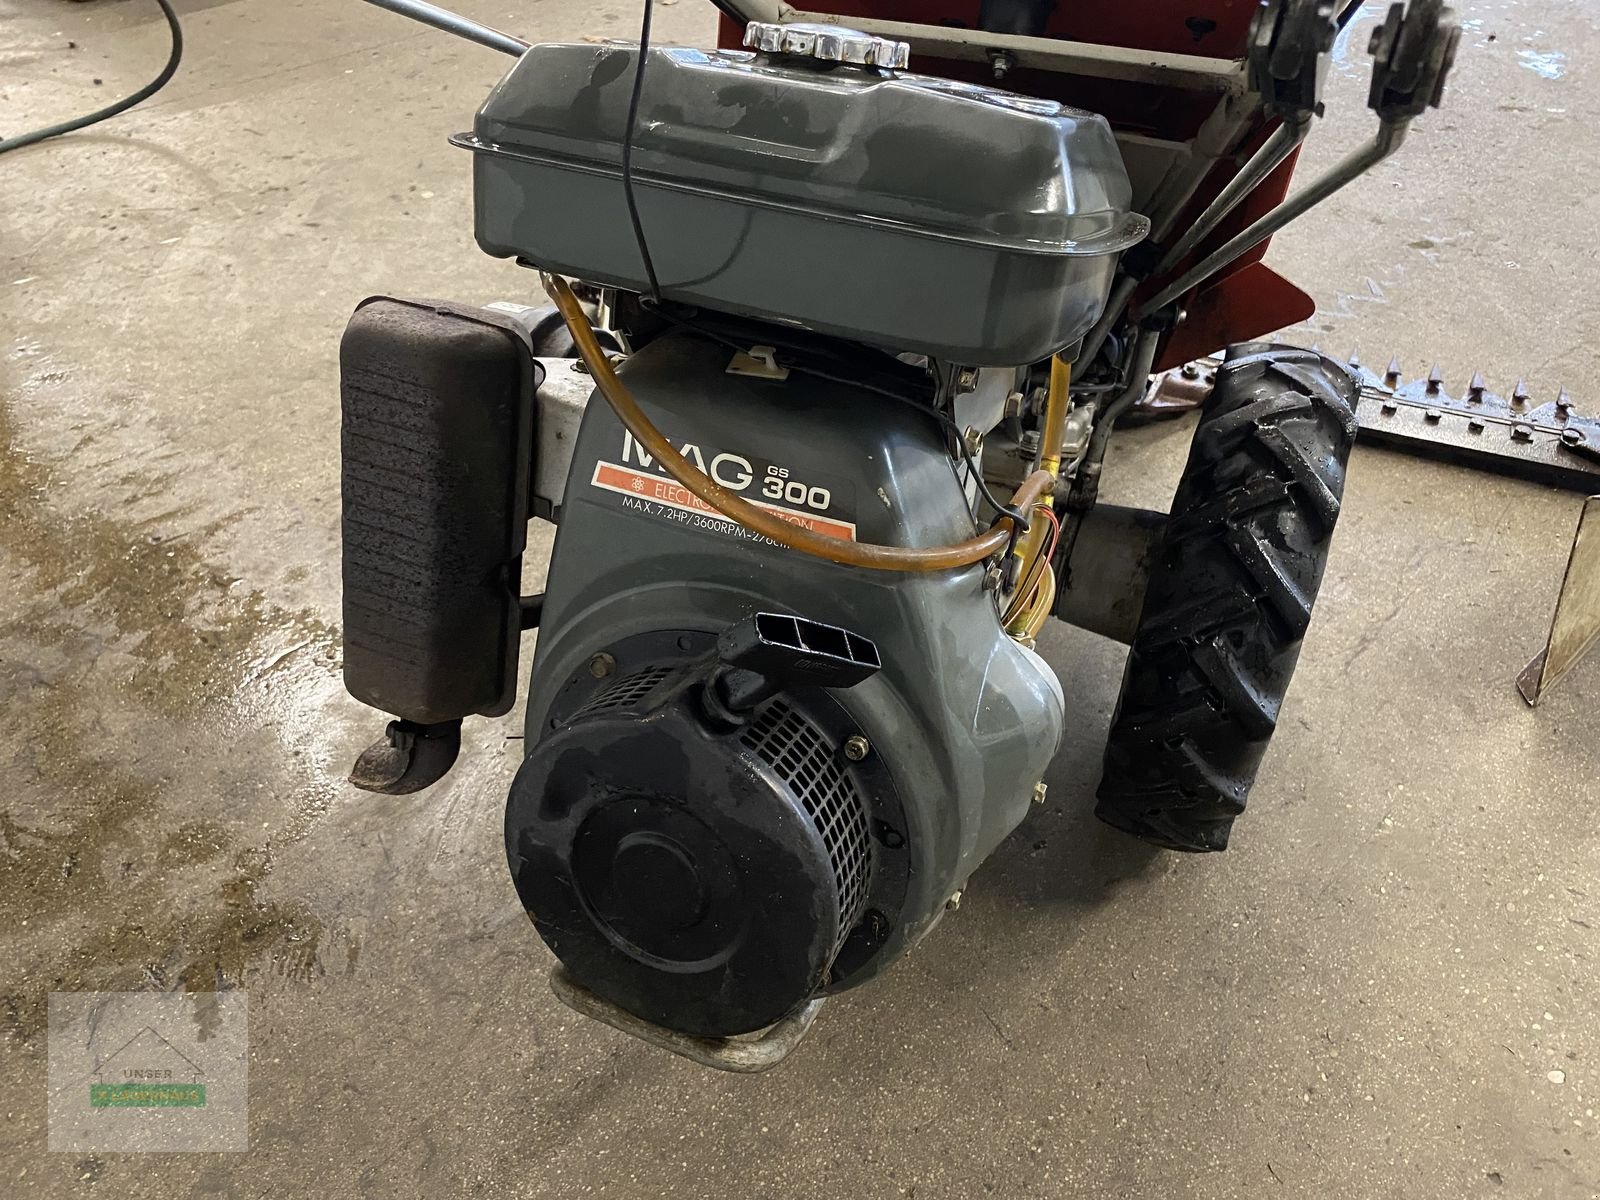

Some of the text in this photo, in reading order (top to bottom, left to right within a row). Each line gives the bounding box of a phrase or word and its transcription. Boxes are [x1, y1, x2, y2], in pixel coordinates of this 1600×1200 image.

[767, 465, 790, 479] GS
[762, 477, 832, 511] 300
[622, 496, 654, 515] MAX.
